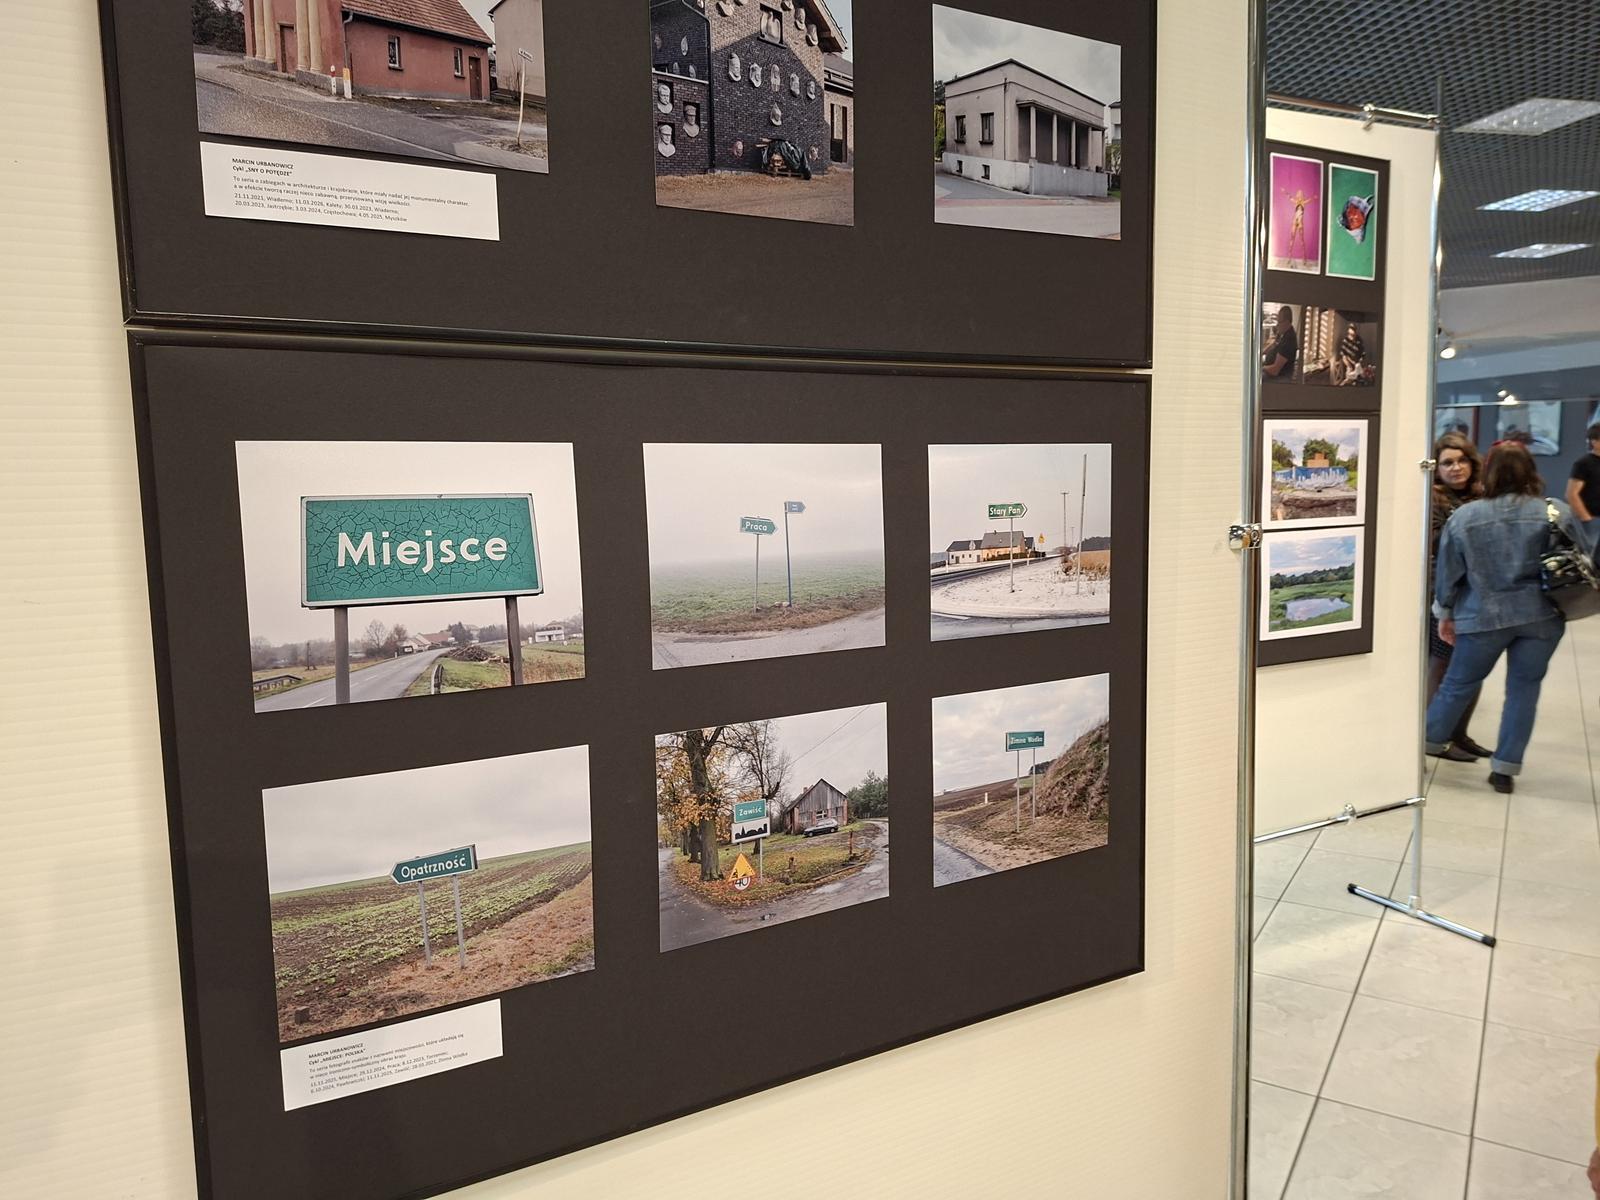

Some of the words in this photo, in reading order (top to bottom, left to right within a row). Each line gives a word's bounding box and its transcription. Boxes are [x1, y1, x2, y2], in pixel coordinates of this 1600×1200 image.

[232, 157, 254, 165] MARCIN
[255, 160, 294, 169] URBANOWICZ
[293, 182, 326, 191] architekturze
[990, 507, 1006, 516] Stary
[1008, 506, 1020, 514] Pan
[745, 521, 768, 531] Praca
[337, 530, 508, 574] Miejsce
[739, 806, 762, 816] Zawiść
[401, 854, 466, 879] Opatrzność
[309, 1050, 328, 1059] MARCIN
[330, 1041, 363, 1054] URBANOWICZ
